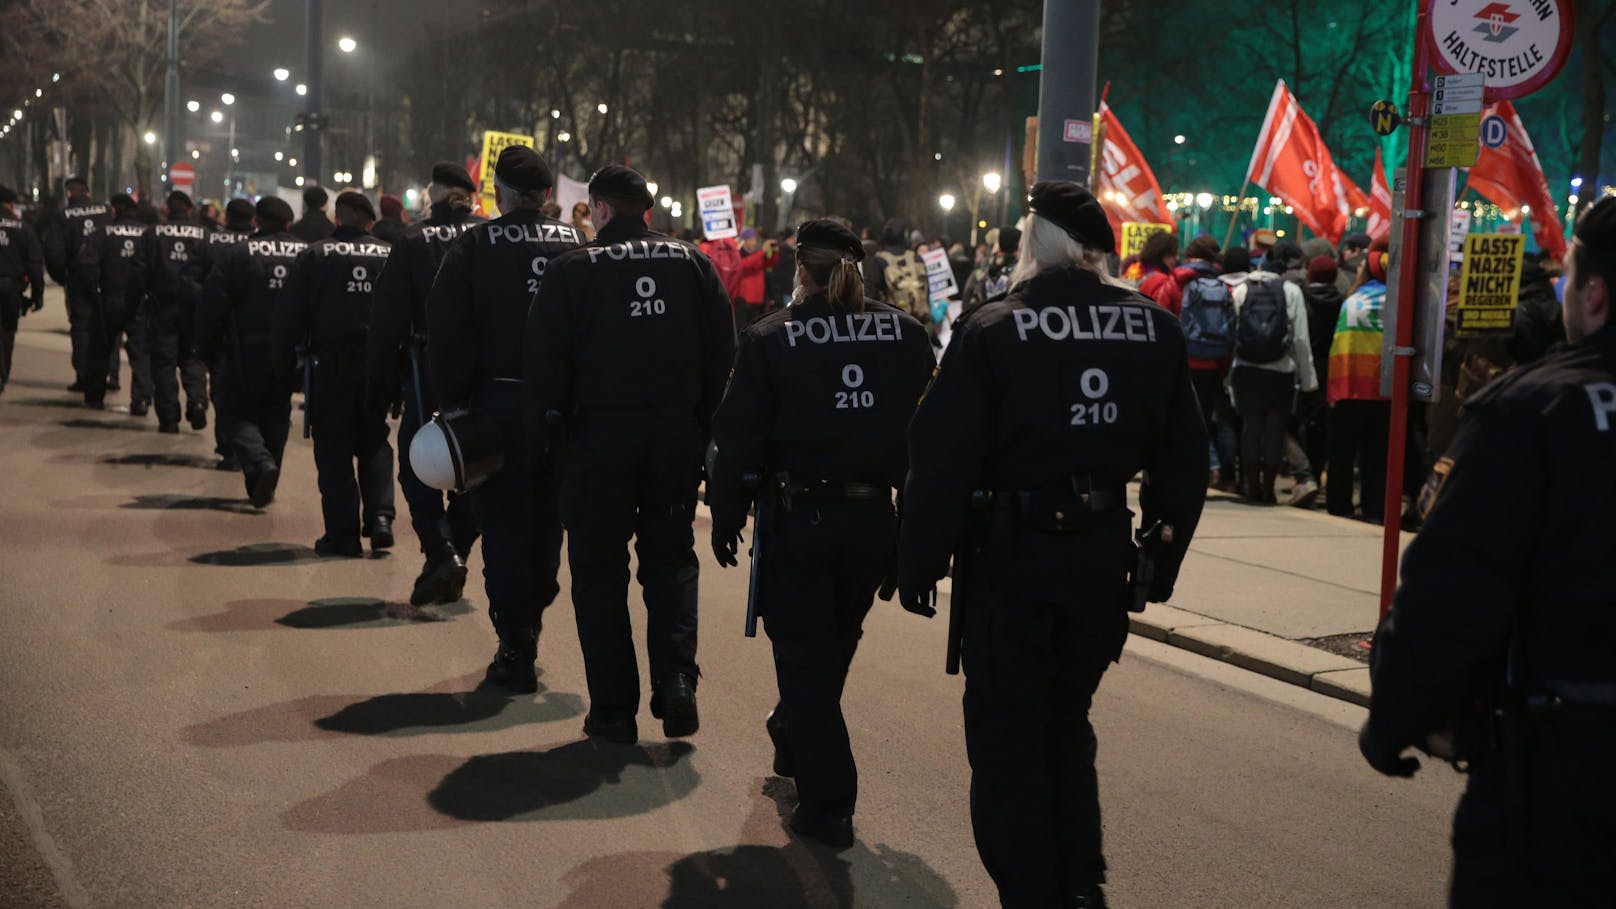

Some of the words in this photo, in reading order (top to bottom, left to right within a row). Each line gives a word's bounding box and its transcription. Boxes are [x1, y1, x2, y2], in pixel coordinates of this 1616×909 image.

[1443, 30, 1543, 79] HALTESTELLE
[1376, 112, 1393, 133] N
[1487, 120, 1503, 144] D
[155, 225, 204, 240] POLIZEI
[488, 224, 580, 245] POLIZEI
[174, 241, 185, 252] O
[587, 240, 691, 263] POLIZEI
[1471, 238, 1519, 255] LASST
[274, 265, 287, 278] O
[352, 266, 367, 280] O
[1469, 258, 1516, 274] NAZIS
[347, 281, 371, 292] 210
[636, 276, 656, 298] O
[1466, 276, 1514, 293] NICHT
[630, 299, 666, 317] 210
[784, 313, 903, 347] POLIZEI
[1012, 305, 1156, 342] POLIZEI
[842, 364, 864, 388] O
[1080, 368, 1109, 399] O
[835, 391, 874, 409] 210
[1070, 402, 1118, 425] 210
